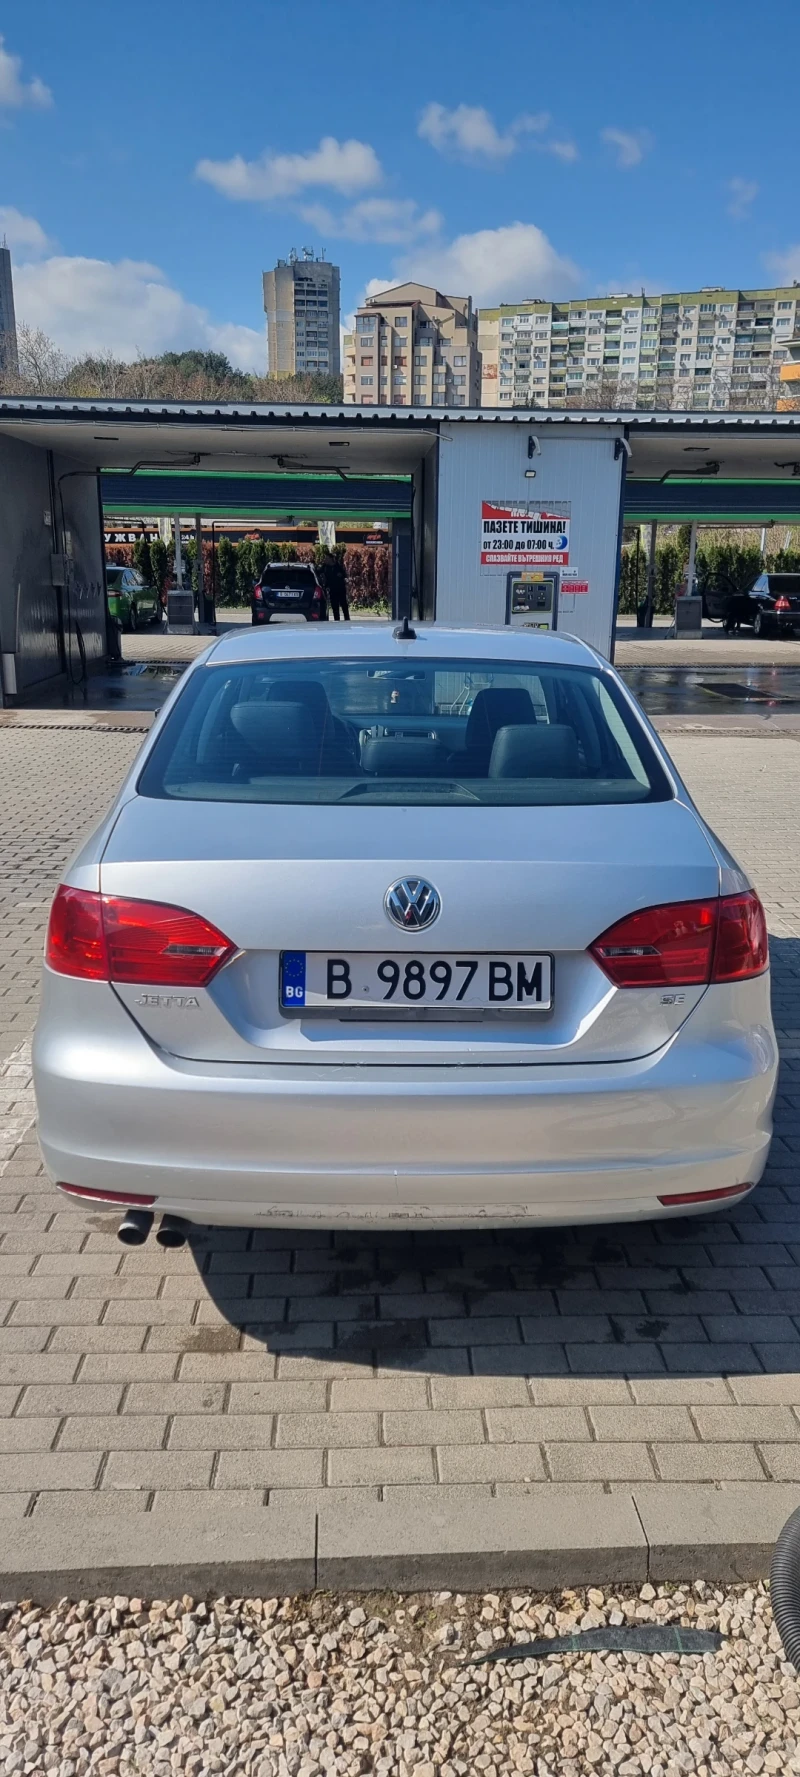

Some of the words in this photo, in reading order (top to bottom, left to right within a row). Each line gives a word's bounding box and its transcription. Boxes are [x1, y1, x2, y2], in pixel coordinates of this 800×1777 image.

[483, 520, 519, 534] ПАЗЕТЕ
[520, 520, 567, 534] ТИШИНА!
[483, 541, 492, 550] от
[492, 539, 514, 550] 23:00
[515, 541, 526, 551] до
[526, 539, 547, 550] 07:00
[552, 554, 564, 564] РЕД
[326, 959, 352, 1000] B
[377, 959, 479, 1001] 9897
[488, 961, 543, 1002] BM
[285, 985, 304, 998] BG
[134, 993, 201, 1008] JETTA
[660, 993, 686, 1006] SE
